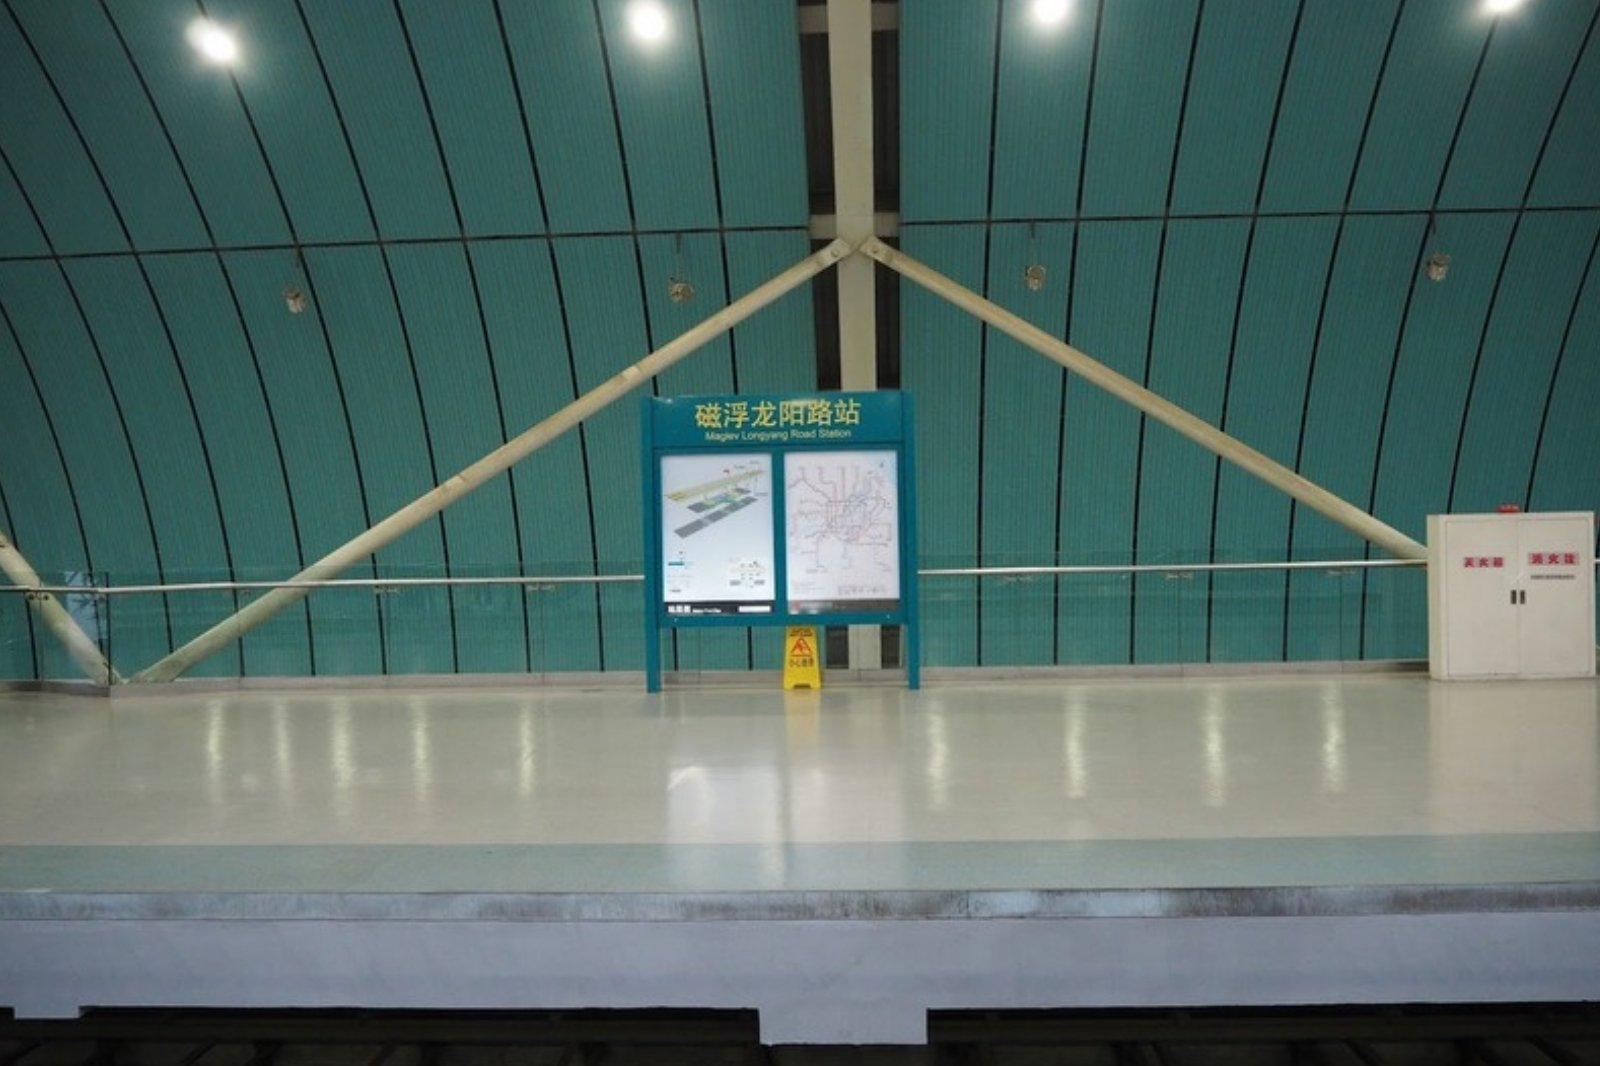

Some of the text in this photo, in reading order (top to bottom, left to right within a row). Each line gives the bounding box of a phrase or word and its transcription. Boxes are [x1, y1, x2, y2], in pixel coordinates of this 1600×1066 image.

[695, 398, 861, 428] 磁浮龙阳路站
[705, 428, 852, 441] Maglev Longyang Road Station
